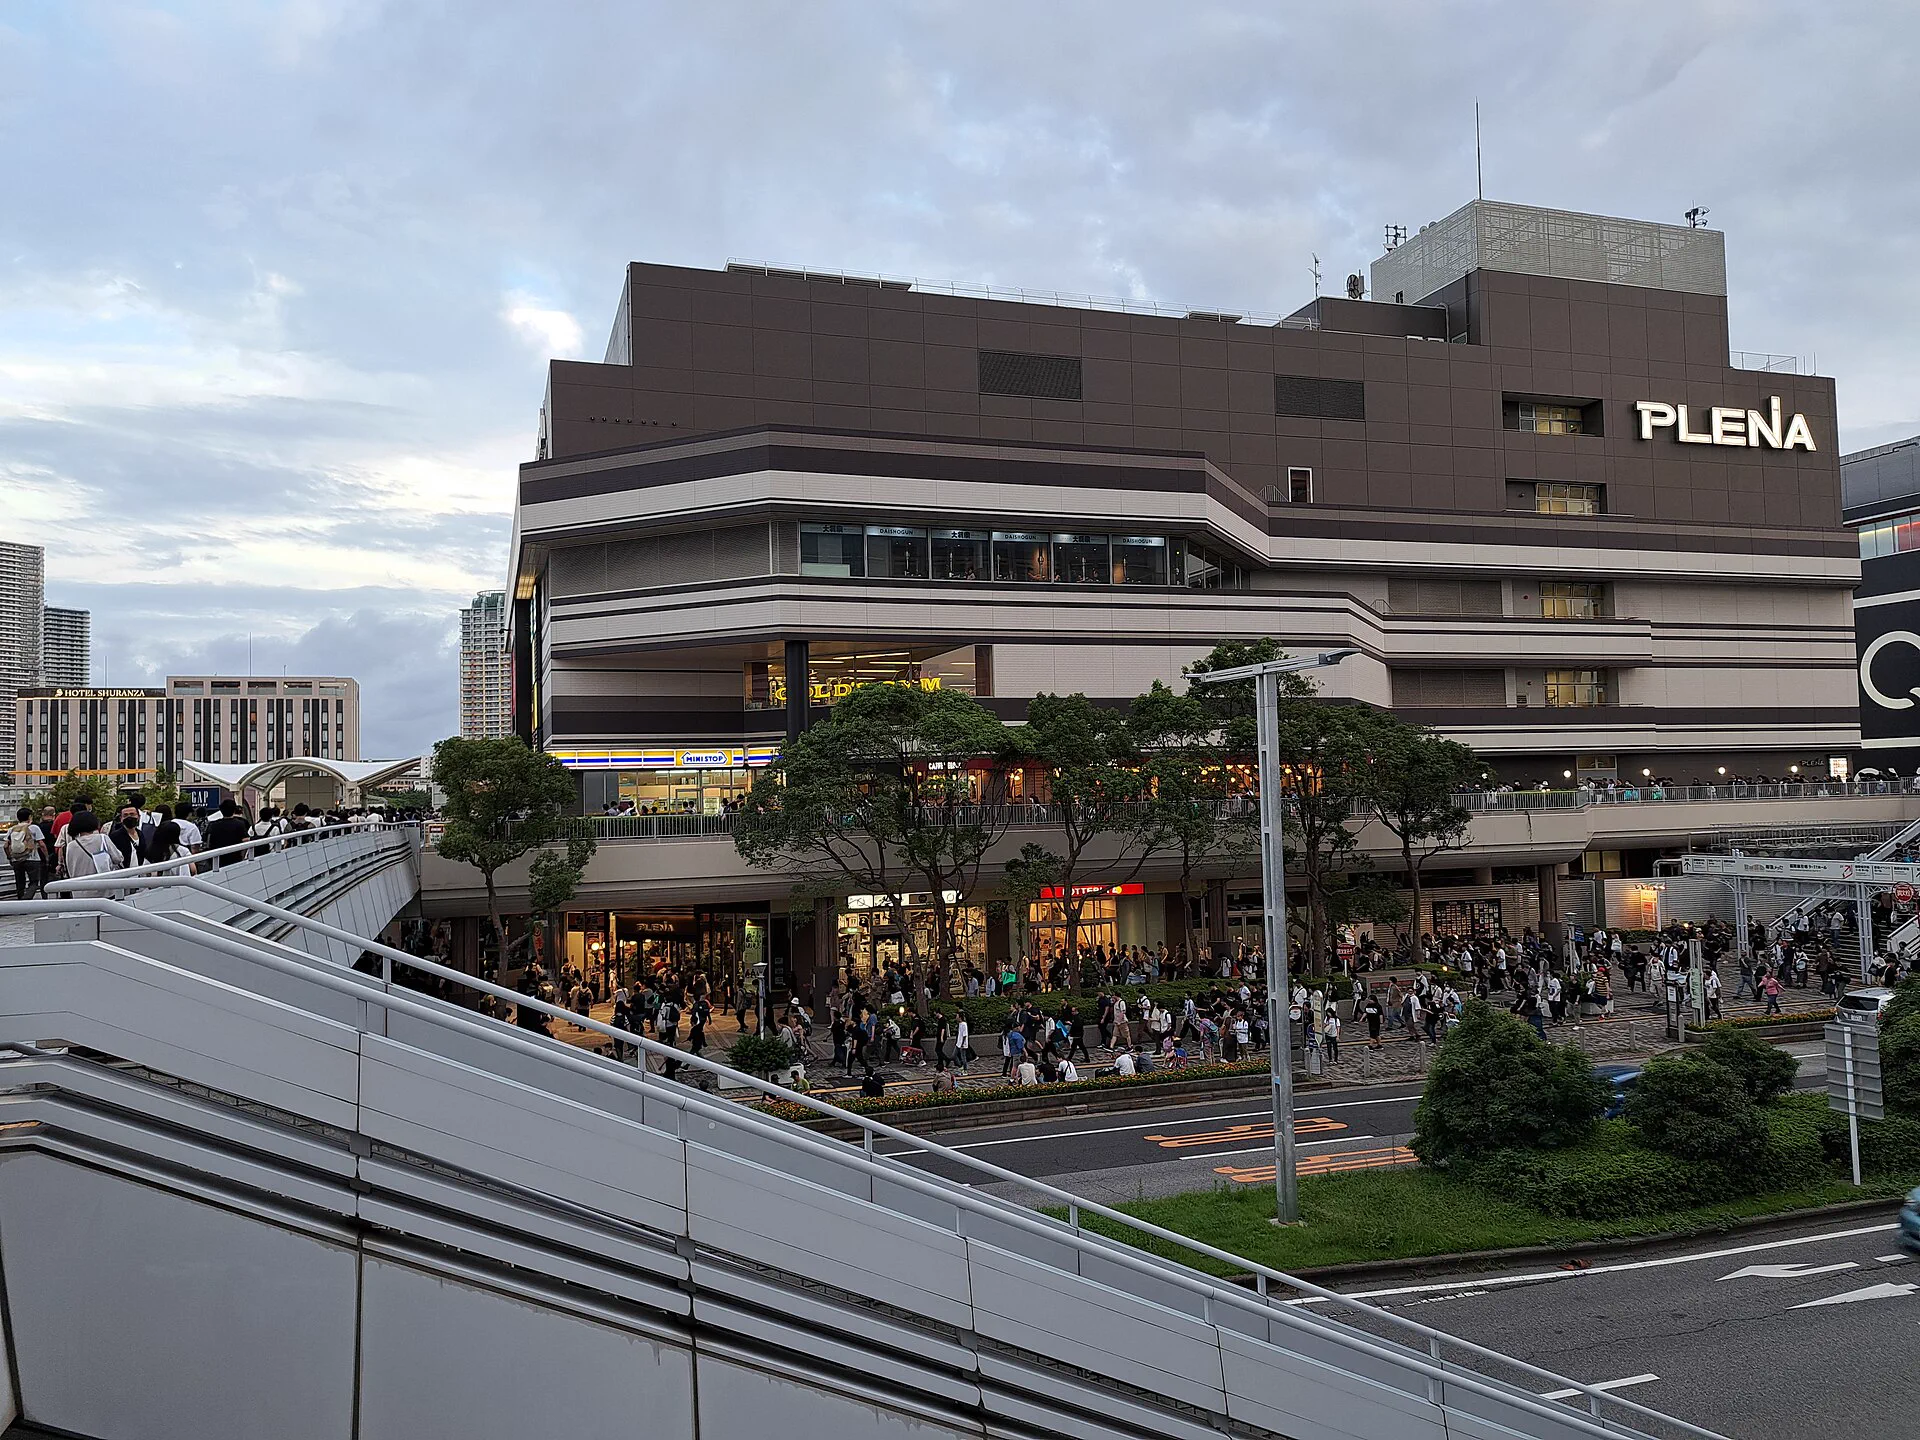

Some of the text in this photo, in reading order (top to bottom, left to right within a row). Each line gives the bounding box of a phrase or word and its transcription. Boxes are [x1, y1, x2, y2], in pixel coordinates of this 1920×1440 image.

[1635, 396, 1817, 451] PLENA
[64, 689, 145, 697] HOTEL SHURANZA
[191, 790, 209, 803] GAP
[636, 921, 674, 932] PLENA
